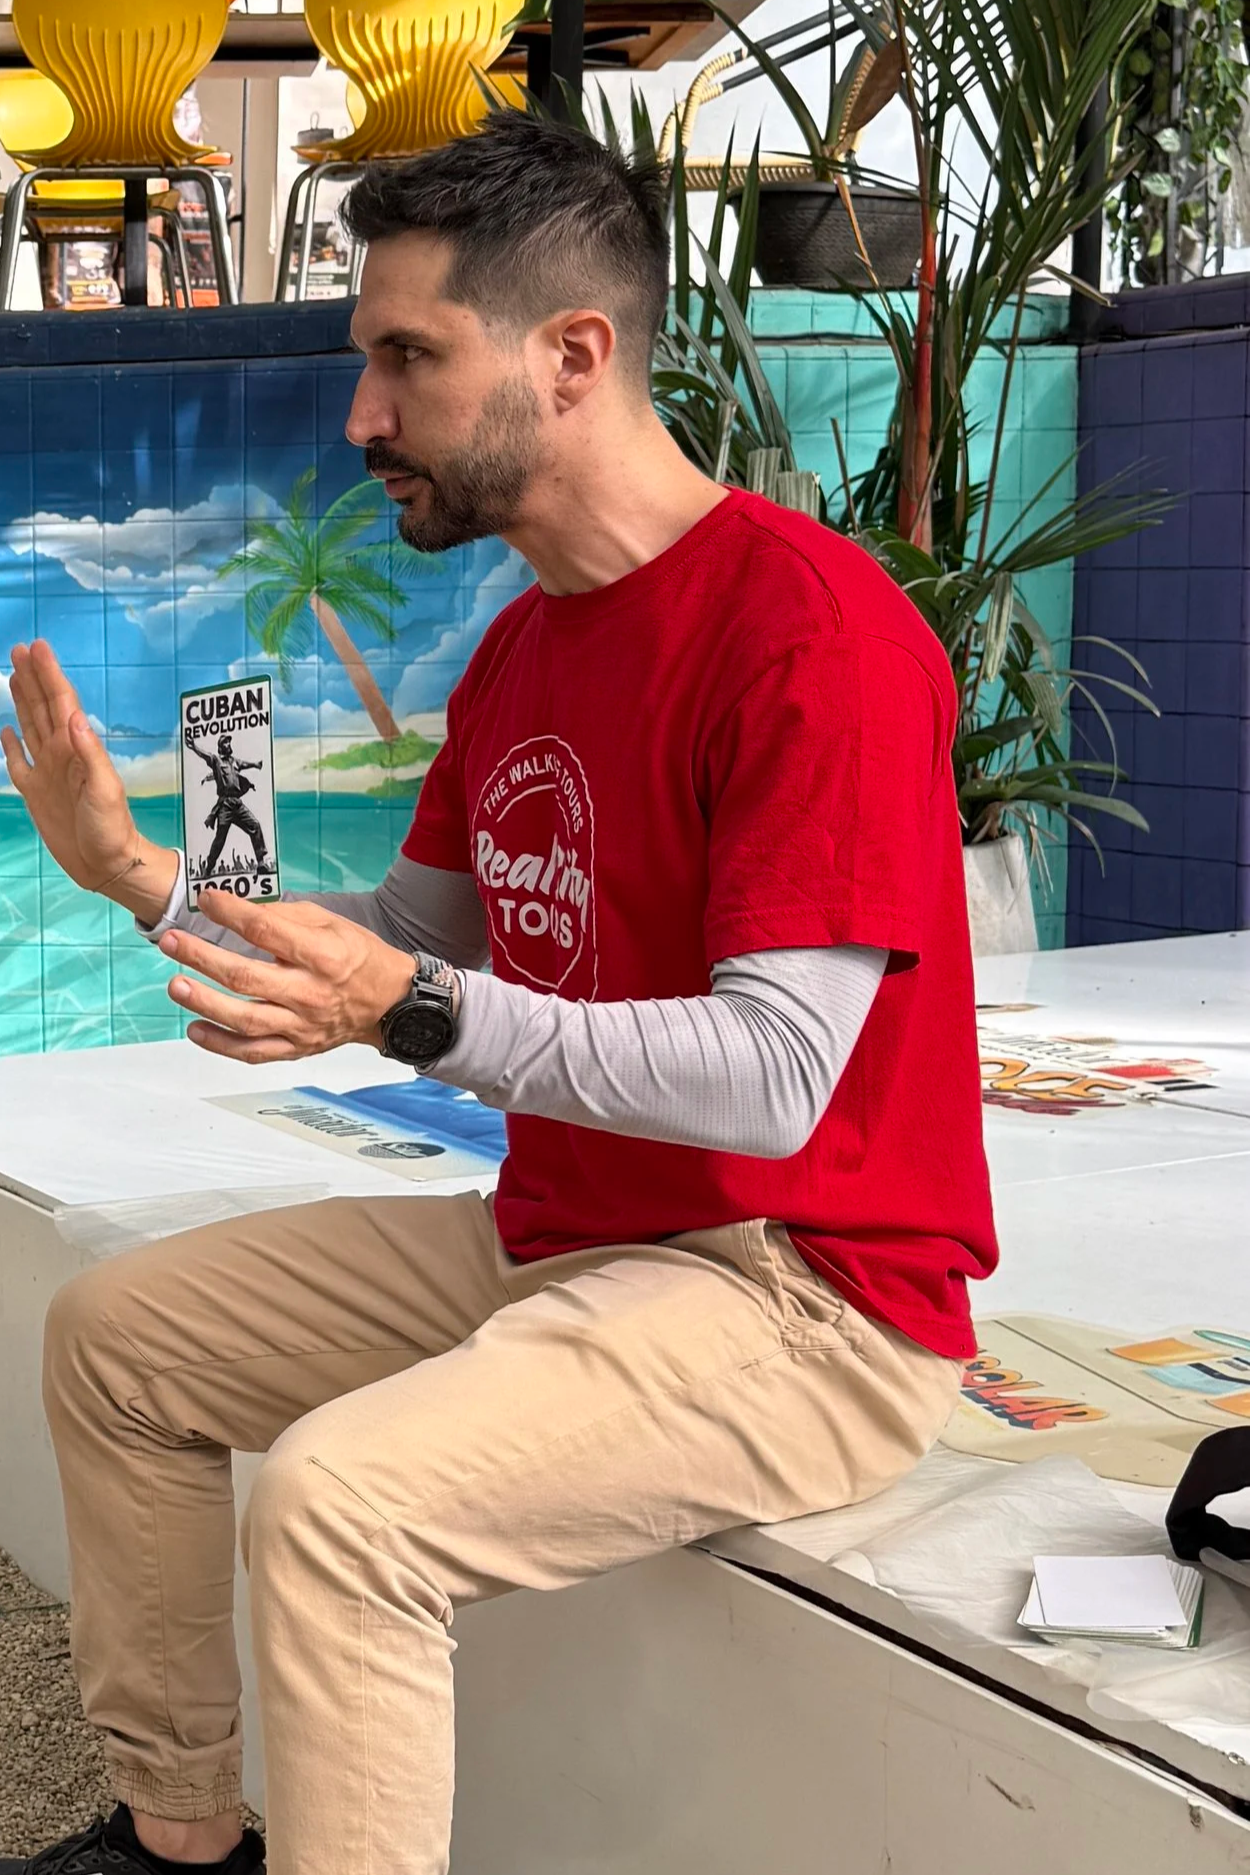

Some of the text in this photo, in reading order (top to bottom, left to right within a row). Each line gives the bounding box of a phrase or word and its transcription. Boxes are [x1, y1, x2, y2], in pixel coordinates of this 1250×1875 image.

[186, 688, 263, 724] CUBAN
[185, 711, 269, 739] REVOLUTION
[484, 777, 509, 815] THE
[560, 768, 583, 833] TOURS
